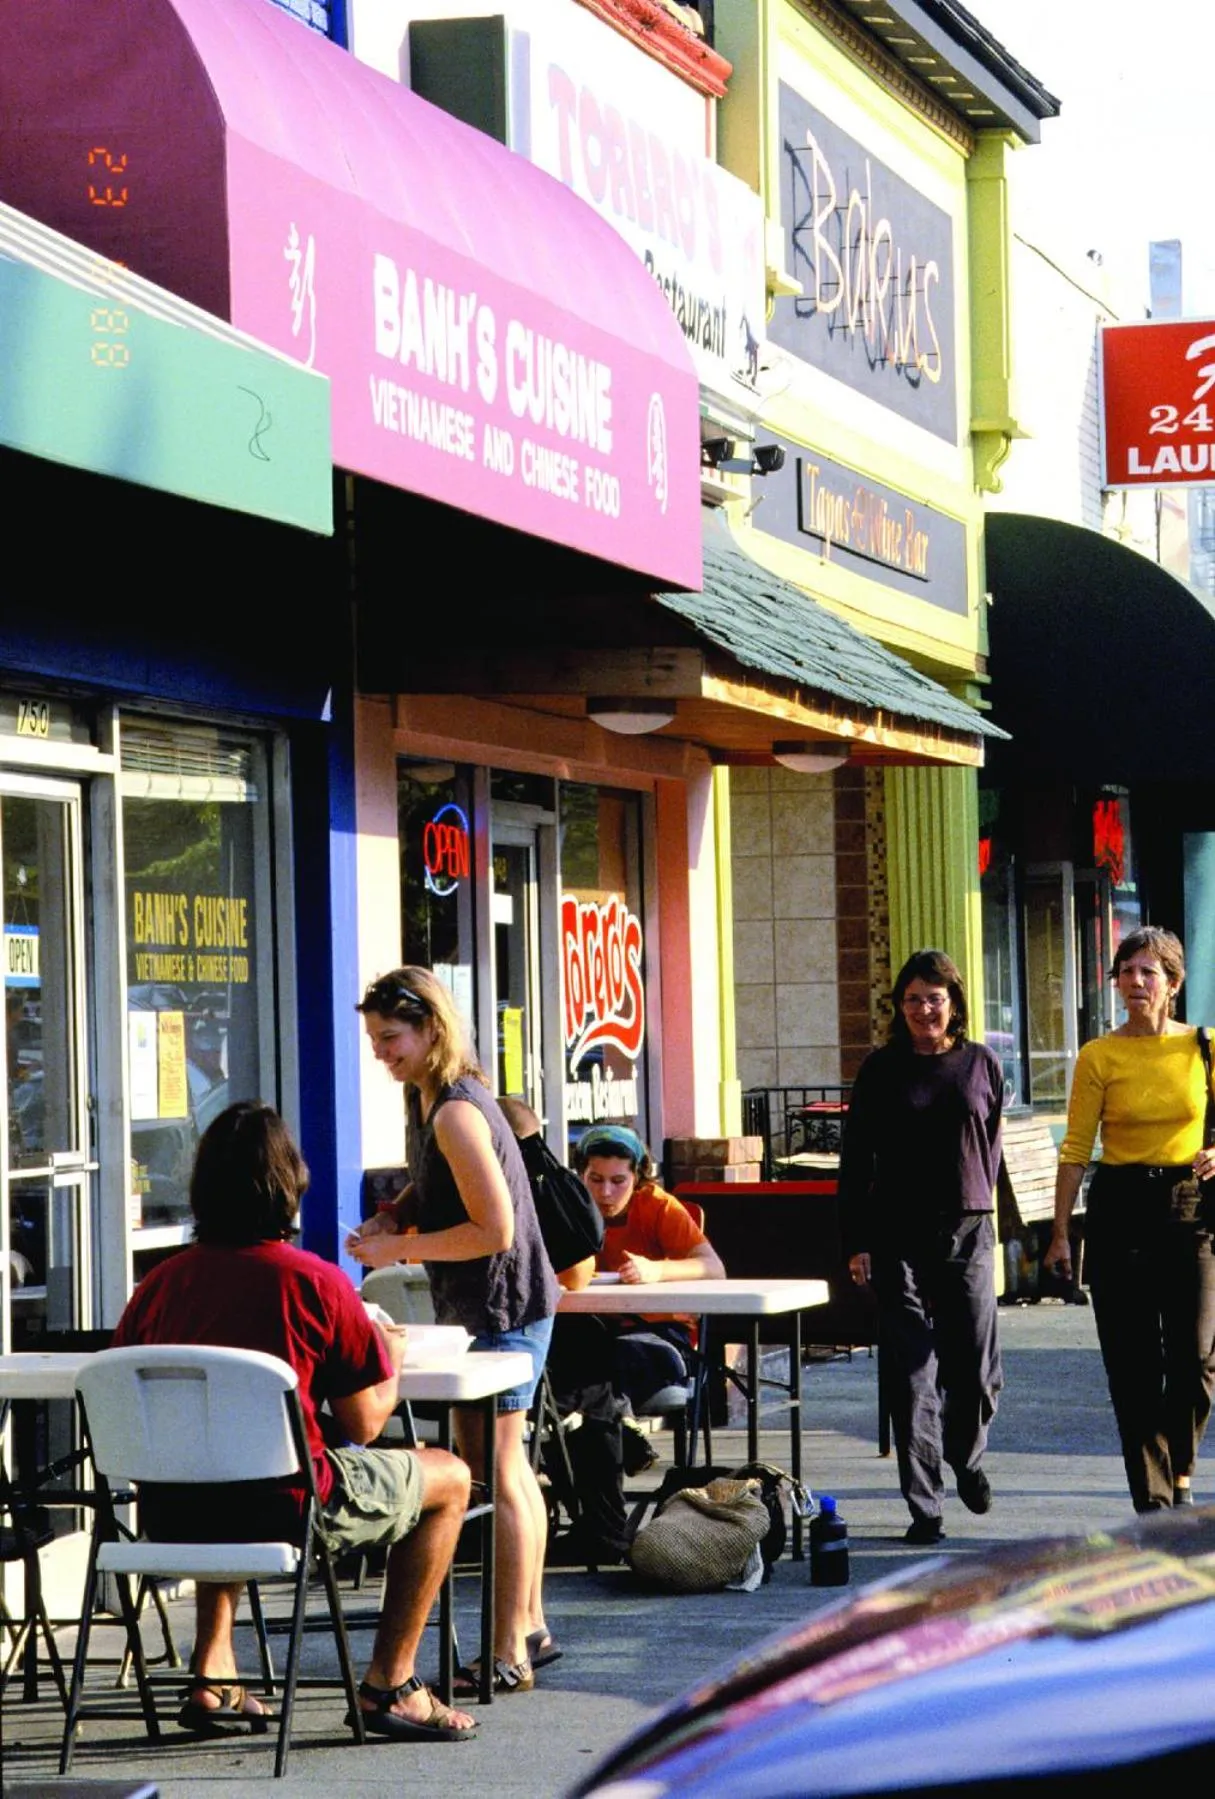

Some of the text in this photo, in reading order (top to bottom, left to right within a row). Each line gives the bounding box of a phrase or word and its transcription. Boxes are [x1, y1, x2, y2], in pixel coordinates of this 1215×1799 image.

[644, 248, 728, 359] staurant
[373, 252, 614, 456] BANH'S CUISINE
[369, 372, 621, 519] VIETNAMESE AND CHINESE FOOD
[1148, 403, 1214, 436] 24
[806, 462, 850, 561] Tapas
[904, 508, 929, 575] Bar
[20, 699, 48, 734] 750
[423, 821, 470, 878] OPEN
[134, 892, 248, 948] BANH'S CUISINE
[9, 937, 33, 974] OPEN
[135, 953, 186, 981] VIETNAMESE
[196, 955, 228, 983] CHINESE
[229, 956, 248, 984] FOOD
